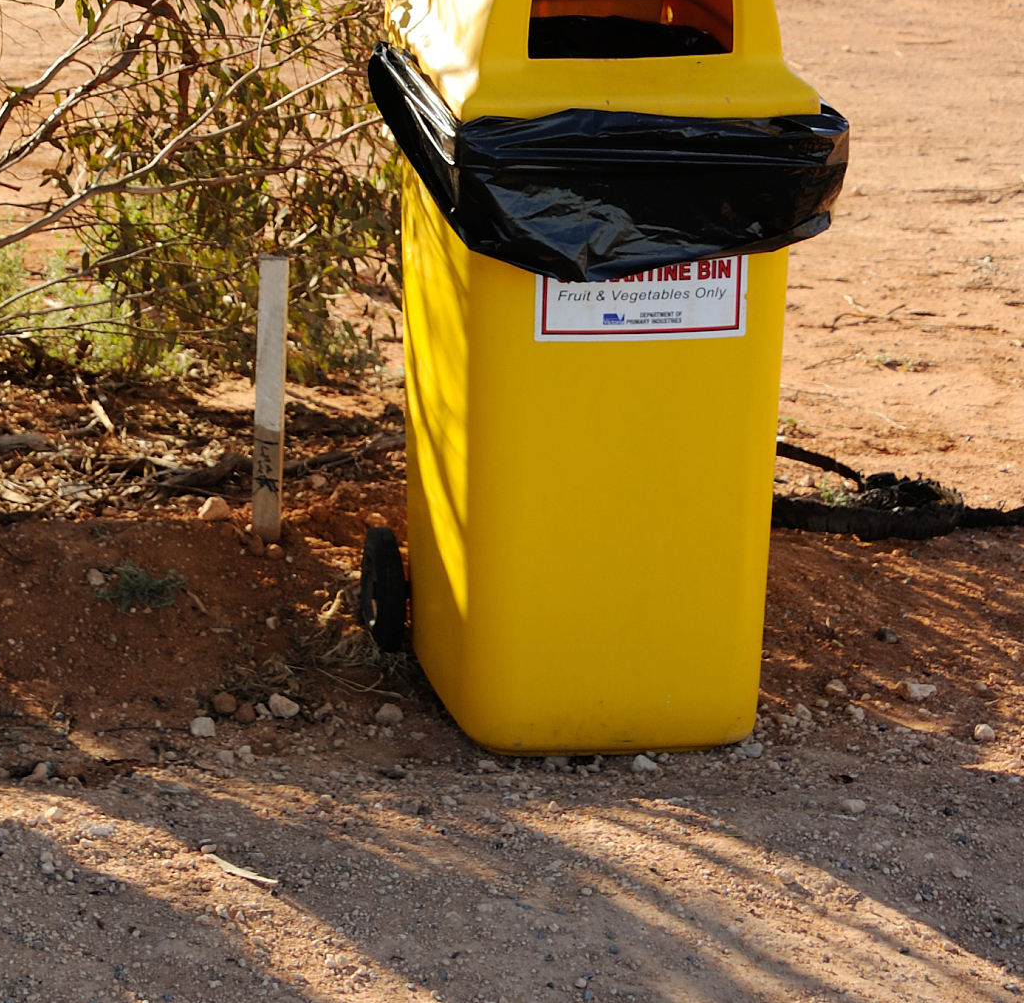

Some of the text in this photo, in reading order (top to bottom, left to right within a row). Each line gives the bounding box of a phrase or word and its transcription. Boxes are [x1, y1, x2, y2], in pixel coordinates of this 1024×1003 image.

[697, 259, 732, 280] BIN
[557, 287, 727, 304] Fruit & Vegetables Only
